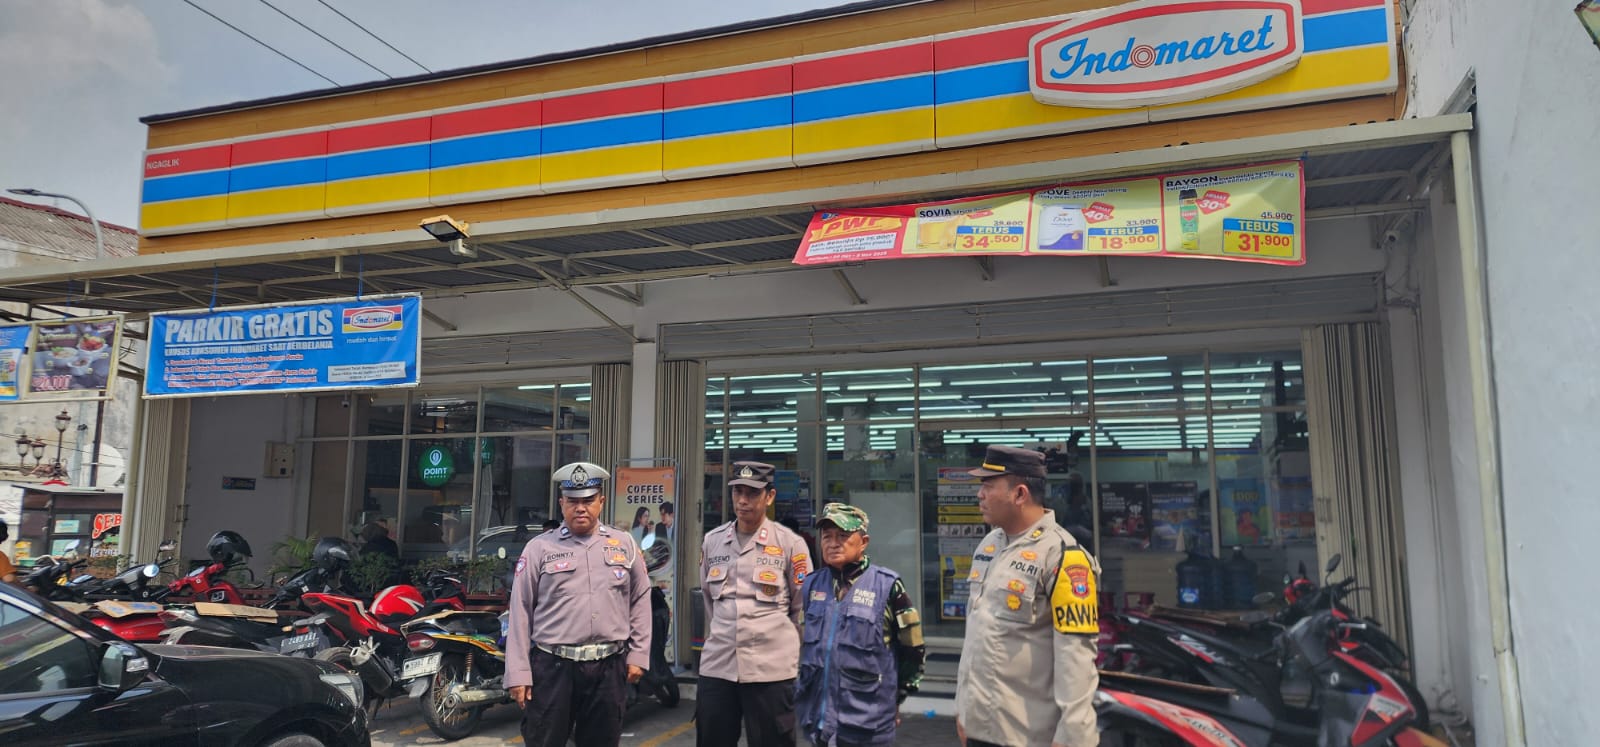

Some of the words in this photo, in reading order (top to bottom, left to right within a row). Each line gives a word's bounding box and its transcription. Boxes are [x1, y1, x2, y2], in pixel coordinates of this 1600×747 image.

[1050, 15, 1275, 79] Indomaret
[146, 158, 179, 169] NGAGLIK
[1166, 175, 1217, 187] BAYGON
[1200, 199, 1227, 210] 30%
[919, 208, 951, 219] SOVIA
[1084, 210, 1110, 222] 40%
[971, 226, 1009, 234] TEBUS
[1104, 227, 1144, 235] TEBUS
[1239, 220, 1279, 233] TEBUS
[962, 235, 1019, 249] 34.500
[1099, 235, 1156, 249] 18.900
[1238, 233, 1290, 253] 31.900
[165, 316, 245, 343] PARKIR
[248, 309, 333, 339] GRATIS
[627, 485, 664, 494] COFFEE
[627, 495, 664, 504] SERIES
[756, 557, 784, 567] POLRI
[1010, 560, 1038, 575] POLRI
